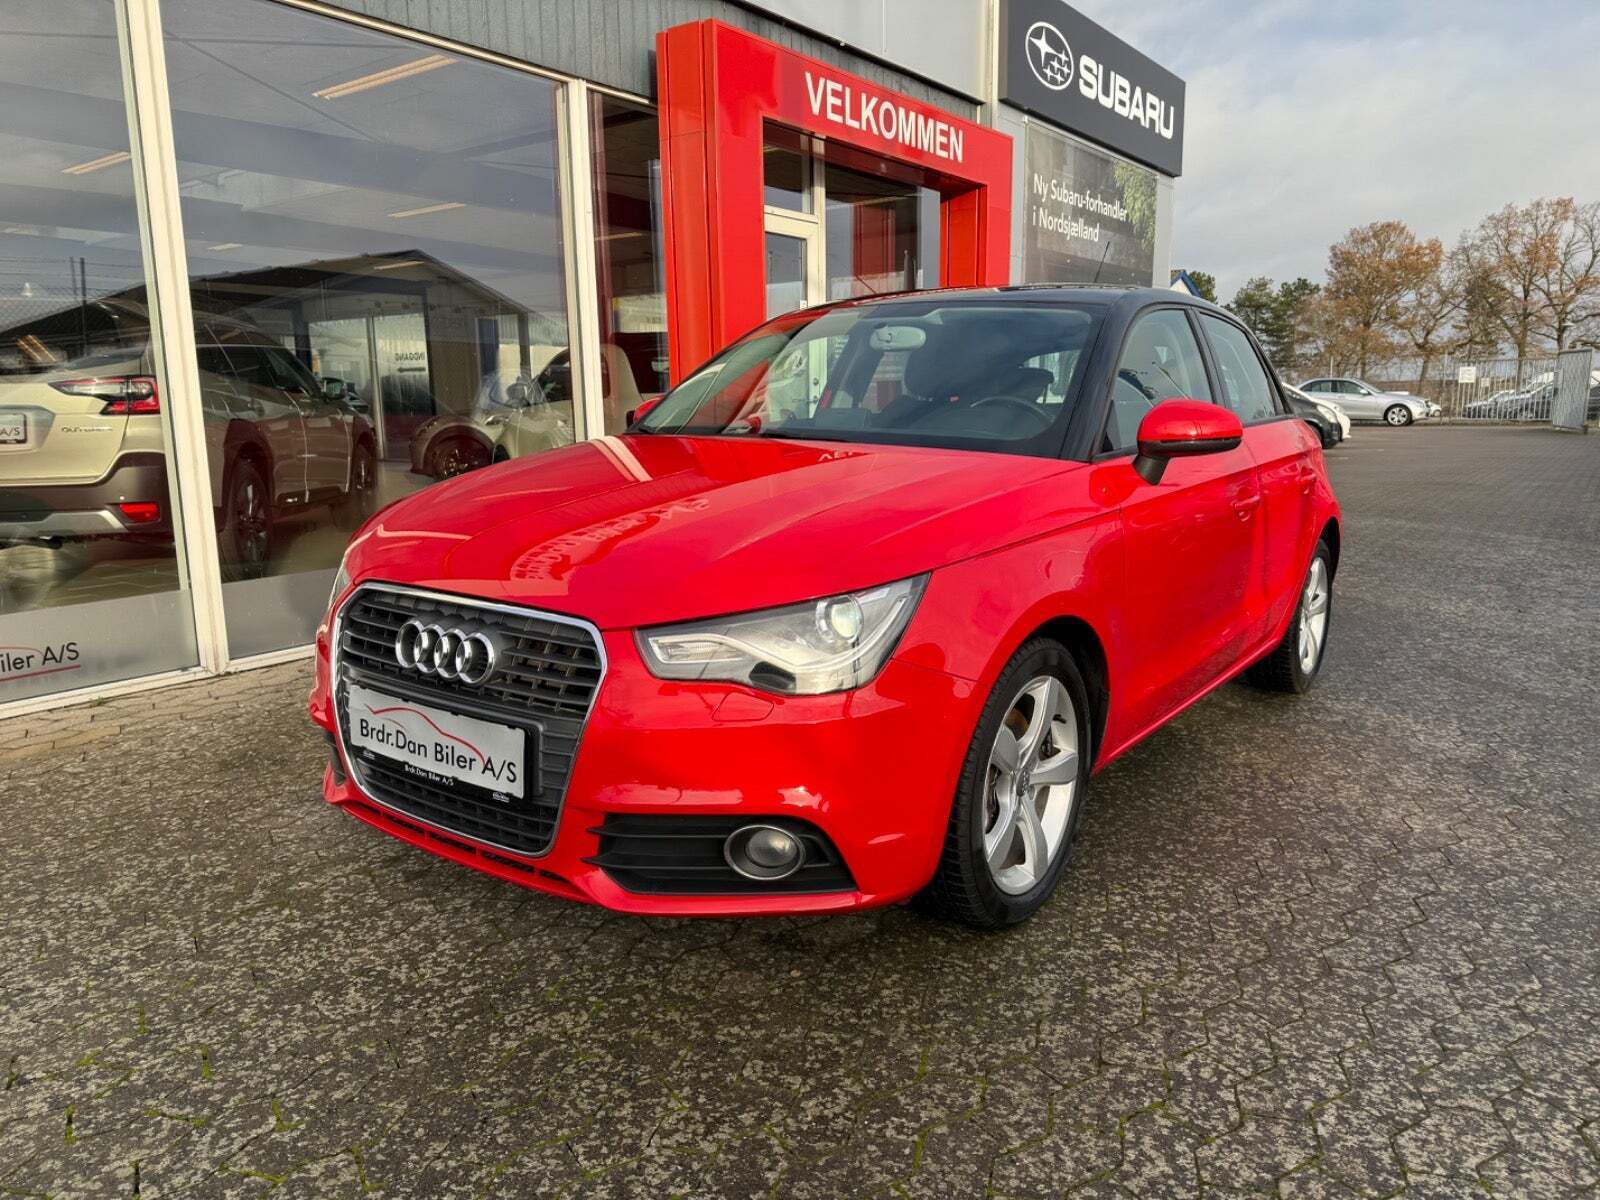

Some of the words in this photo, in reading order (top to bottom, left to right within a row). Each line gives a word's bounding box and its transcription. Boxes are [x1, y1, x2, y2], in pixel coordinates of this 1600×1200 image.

[805, 71, 963, 163] VELKOMMEN
[1079, 54, 1174, 140] SUBARU
[1032, 206, 1037, 226] i
[1039, 207, 1099, 242] Nordsjælland
[1033, 173, 1048, 202] Ny
[1050, 180, 1127, 222] Subaru-forhandler
[42, 642, 80, 666] A/S
[360, 718, 428, 758] Brdr.Dan
[434, 742, 477, 771] Biler
[481, 756, 517, 784] A/S
